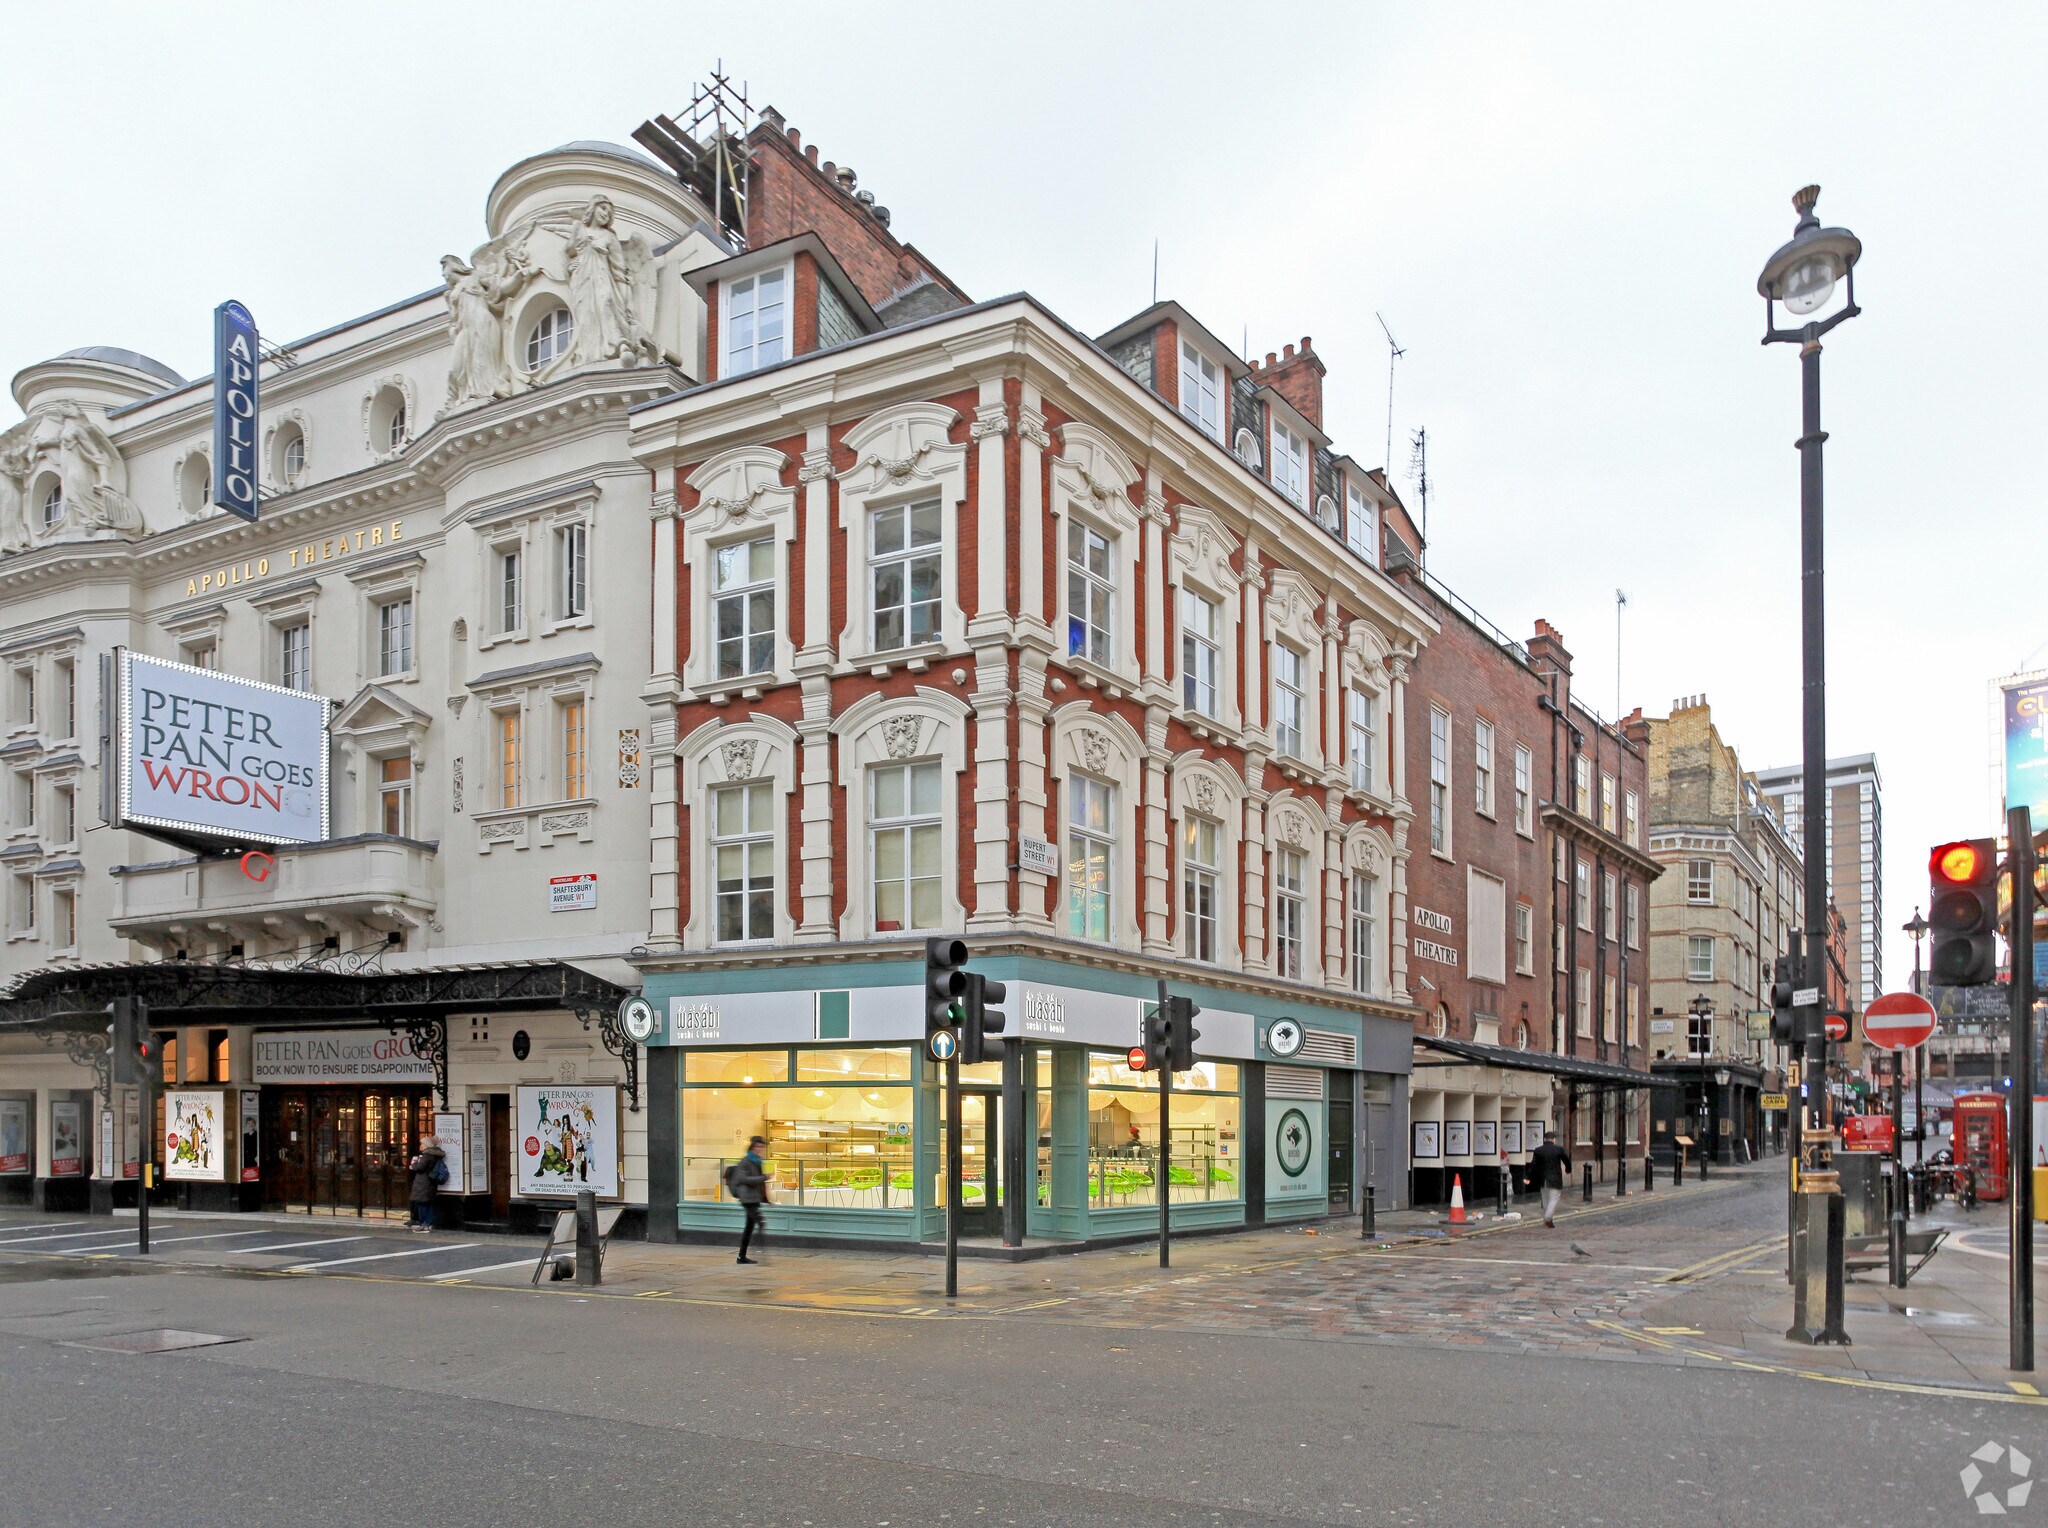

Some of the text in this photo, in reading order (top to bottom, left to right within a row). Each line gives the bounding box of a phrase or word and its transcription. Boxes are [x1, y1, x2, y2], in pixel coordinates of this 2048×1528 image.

[226, 333, 254, 503] APOLLO
[187, 520, 403, 597] APOLLO THEATRE
[141, 688, 283, 749] PETER
[140, 723, 314, 788] PAN GOES
[1023, 839, 1046, 853] RUPERT
[240, 850, 275, 883] G
[1023, 849, 1045, 863] STREET
[1046, 855, 1055, 866] W1
[552, 883, 593, 895] SHAFTESBURY
[552, 893, 585, 903] AVENUE W1
[1416, 909, 1450, 933] APOLLO
[1416, 940, 1457, 965] THEATRE
[676, 1006, 720, 1029] wasabi
[1025, 997, 1066, 1024] wasabi
[677, 1030, 693, 1039] sushi
[702, 1030, 720, 1038] bento
[1026, 1021, 1042, 1031] sushi
[1049, 1022, 1065, 1034] bento
[256, 1041, 304, 1061] PETER
[307, 1039, 341, 1060] PAN
[342, 1045, 371, 1060] GOES
[256, 1065, 281, 1076] BOOK
[284, 1064, 306, 1075] NOW
[308, 1064, 320, 1075] TO
[322, 1063, 358, 1075] ENSURE
[538, 1090, 594, 1099] PETER PAN GOES
